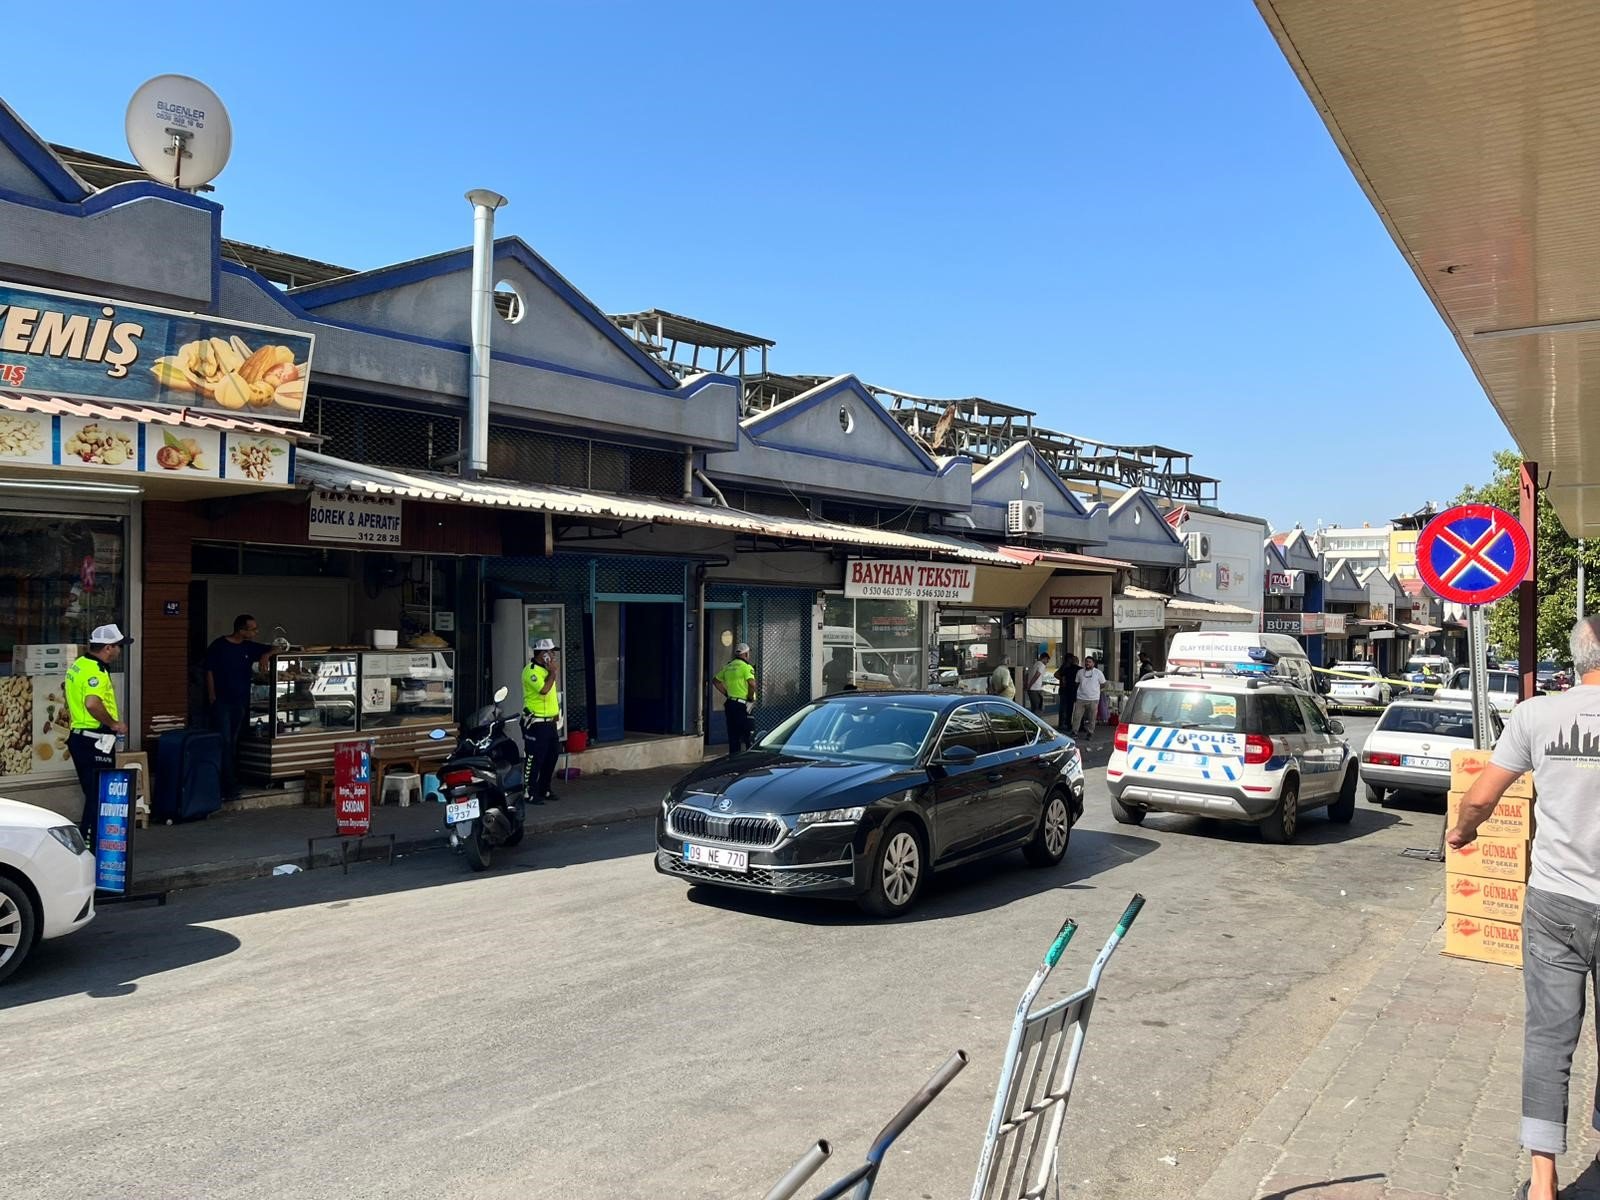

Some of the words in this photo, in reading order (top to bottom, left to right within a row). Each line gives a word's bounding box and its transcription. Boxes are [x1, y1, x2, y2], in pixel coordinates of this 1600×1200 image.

[310, 506, 345, 526] BÖREK
[348, 511, 355, 526] &
[358, 532, 374, 541] 312
[851, 562, 914, 586] BAYHAN
[863, 587, 868, 595] 0
[869, 587, 881, 596] 530
[882, 587, 895, 596] 463
[895, 588, 902, 596] 37
[903, 588, 912, 596] 56
[916, 589, 921, 597] 0
[921, 589, 933, 597] 546
[952, 590, 959, 598] 54
[1051, 598, 1100, 607] YUMAK
[1267, 619, 1300, 630] BÜFE
[108, 778, 128, 798] GÜÇLÜ
[341, 800, 365, 813] ASKIDAN
[448, 805, 459, 813] 09
[466, 801, 477, 809] NZ
[454, 811, 470, 819] 737
[690, 846, 701, 860] 09
[708, 849, 720, 863] NE
[727, 851, 745, 867] 770
[1482, 841, 1518, 860] GÜNBAK
[1483, 882, 1519, 902] GÜNBAK
[1483, 923, 1519, 942] GÜNBAK
